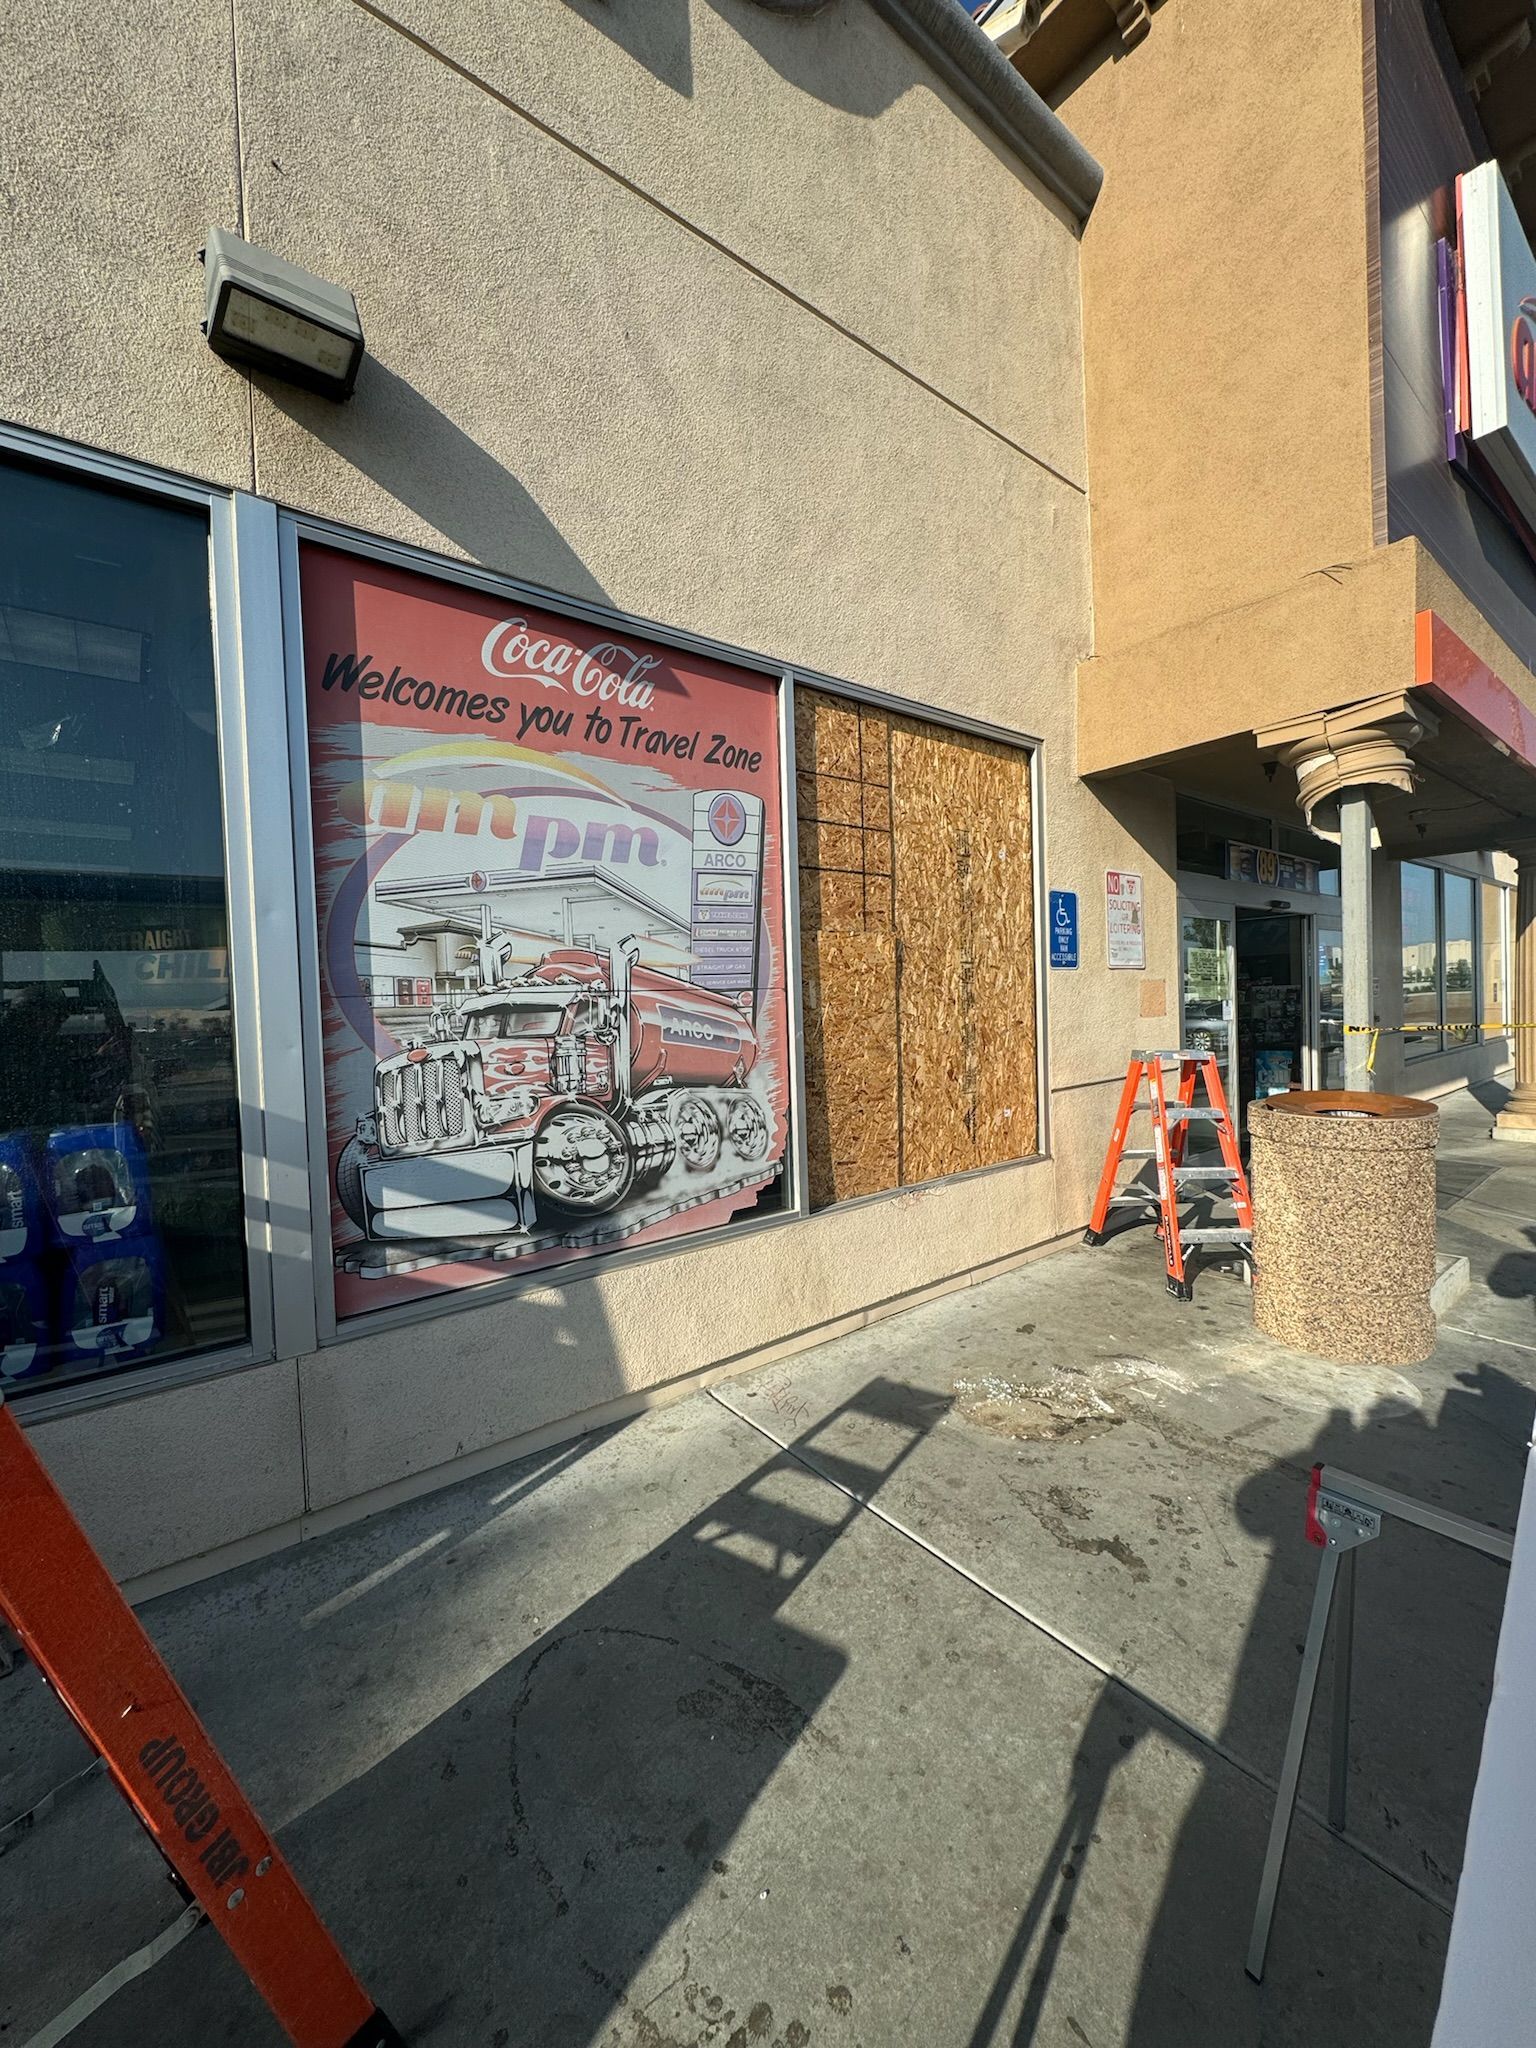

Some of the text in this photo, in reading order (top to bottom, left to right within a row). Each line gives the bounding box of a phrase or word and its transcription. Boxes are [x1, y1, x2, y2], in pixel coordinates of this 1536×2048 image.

[321, 652, 762, 772] Welcomes you to Travel Zone
[704, 853, 746, 868] ARCO
[1108, 875, 1119, 892] NO
[1109, 899, 1140, 911] SOLICITING
[1055, 927, 1072, 935] PARKING
[1110, 923, 1140, 934] LOITERING
[1058, 936, 1069, 944] ONLY
[455, 950, 480, 963] amp
[1052, 953, 1077, 961] ACCESSIBLE
[136, 953, 230, 979] CHIL
[669, 1018, 714, 1040] ARCO
[7, 1190, 24, 1228] smart
[99, 1286, 108, 1324] smart
[139, 1735, 250, 1888] JBI GROUP
